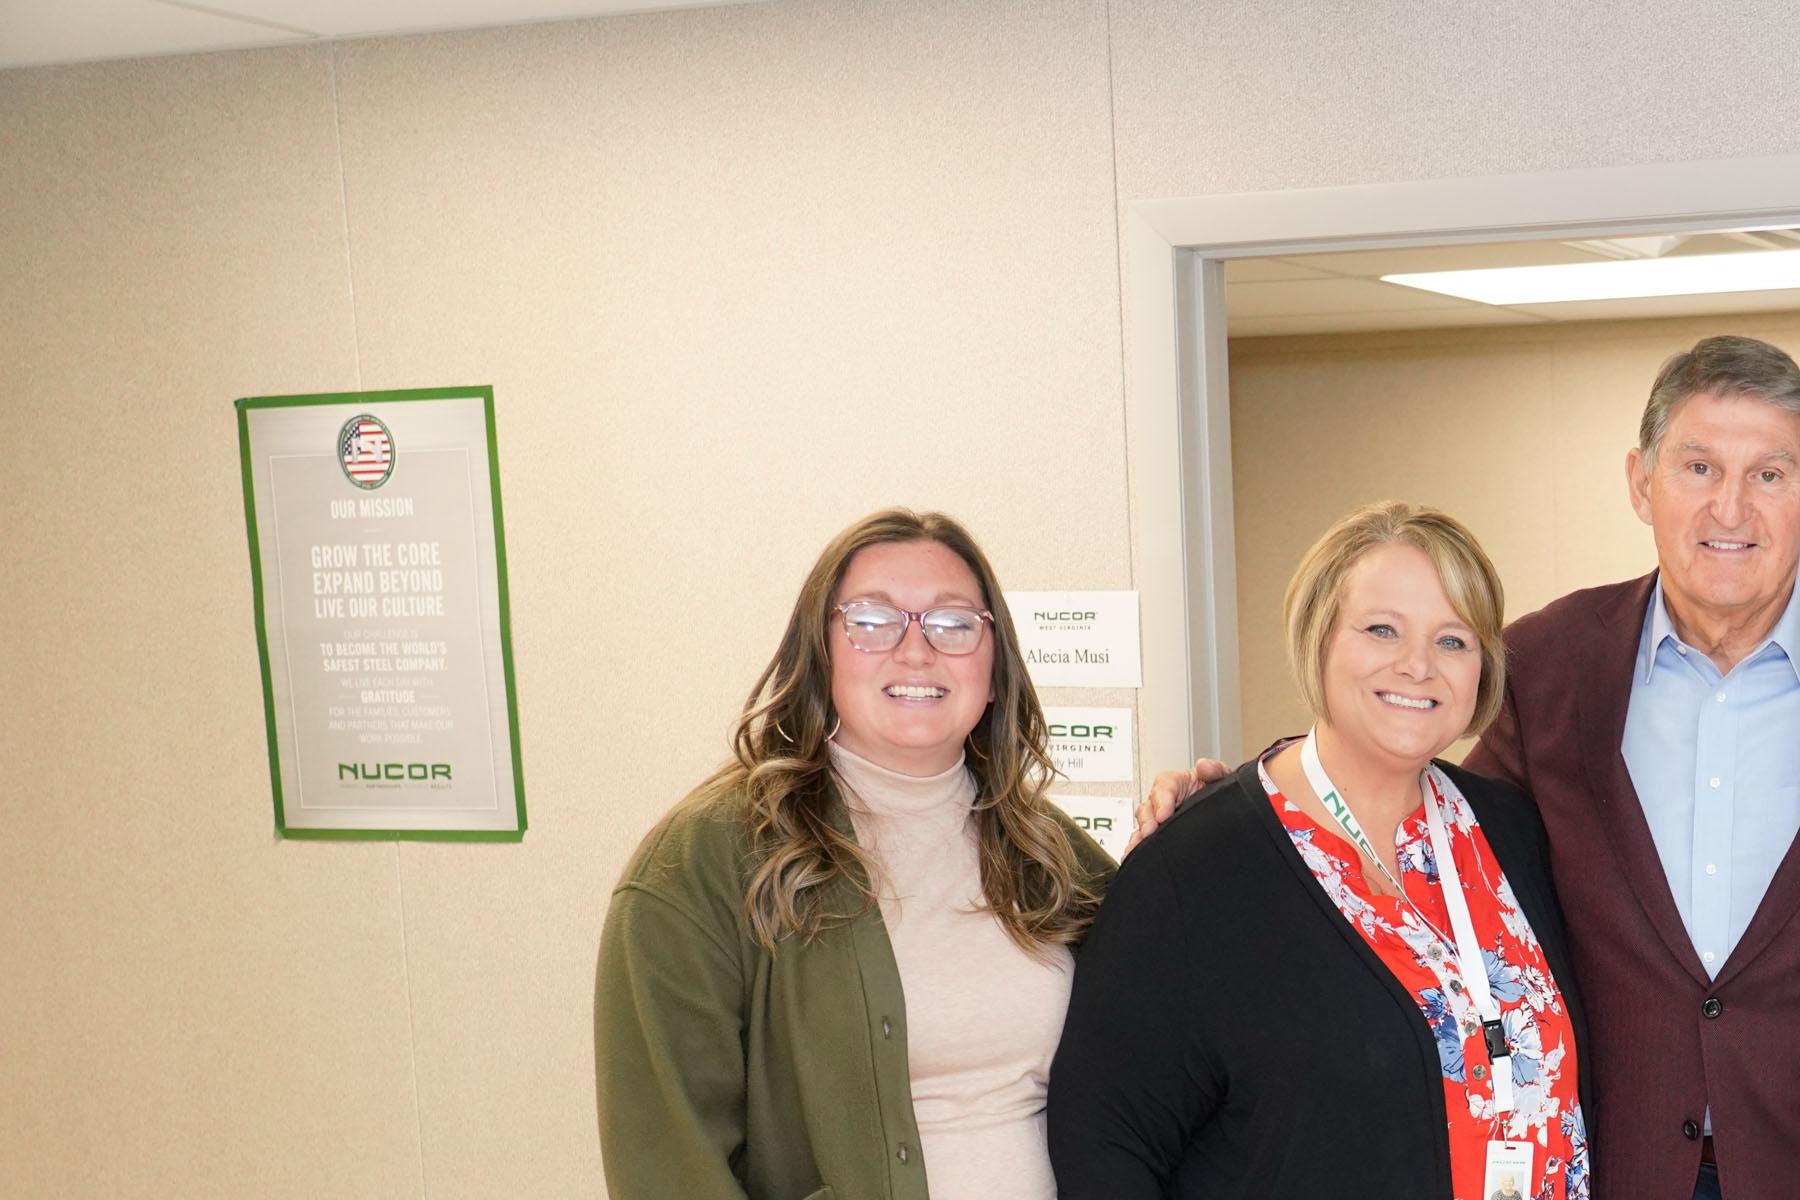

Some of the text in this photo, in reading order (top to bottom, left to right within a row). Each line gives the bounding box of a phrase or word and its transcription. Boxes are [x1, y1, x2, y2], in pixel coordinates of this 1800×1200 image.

[330, 496, 415, 519] OUR MISSION
[311, 541, 441, 569] GROW THE CORE
[313, 568, 443, 595] EXPAND BEYOND
[314, 595, 445, 619] LIVE OUR CULTURE
[1034, 611, 1096, 621] NUCOR
[320, 640, 447, 656] TO BECOME THE WORLD'S
[1026, 647, 1110, 664] Alecia Musi
[323, 656, 448, 672] SAFEST STEEL COMPANY.
[360, 690, 416, 704] GRATITUDE
[1048, 724, 1113, 739] COR
[1049, 744, 1105, 752] VIRGINIA
[1068, 757, 1084, 769] Hill
[338, 763, 452, 780] NUCOR
